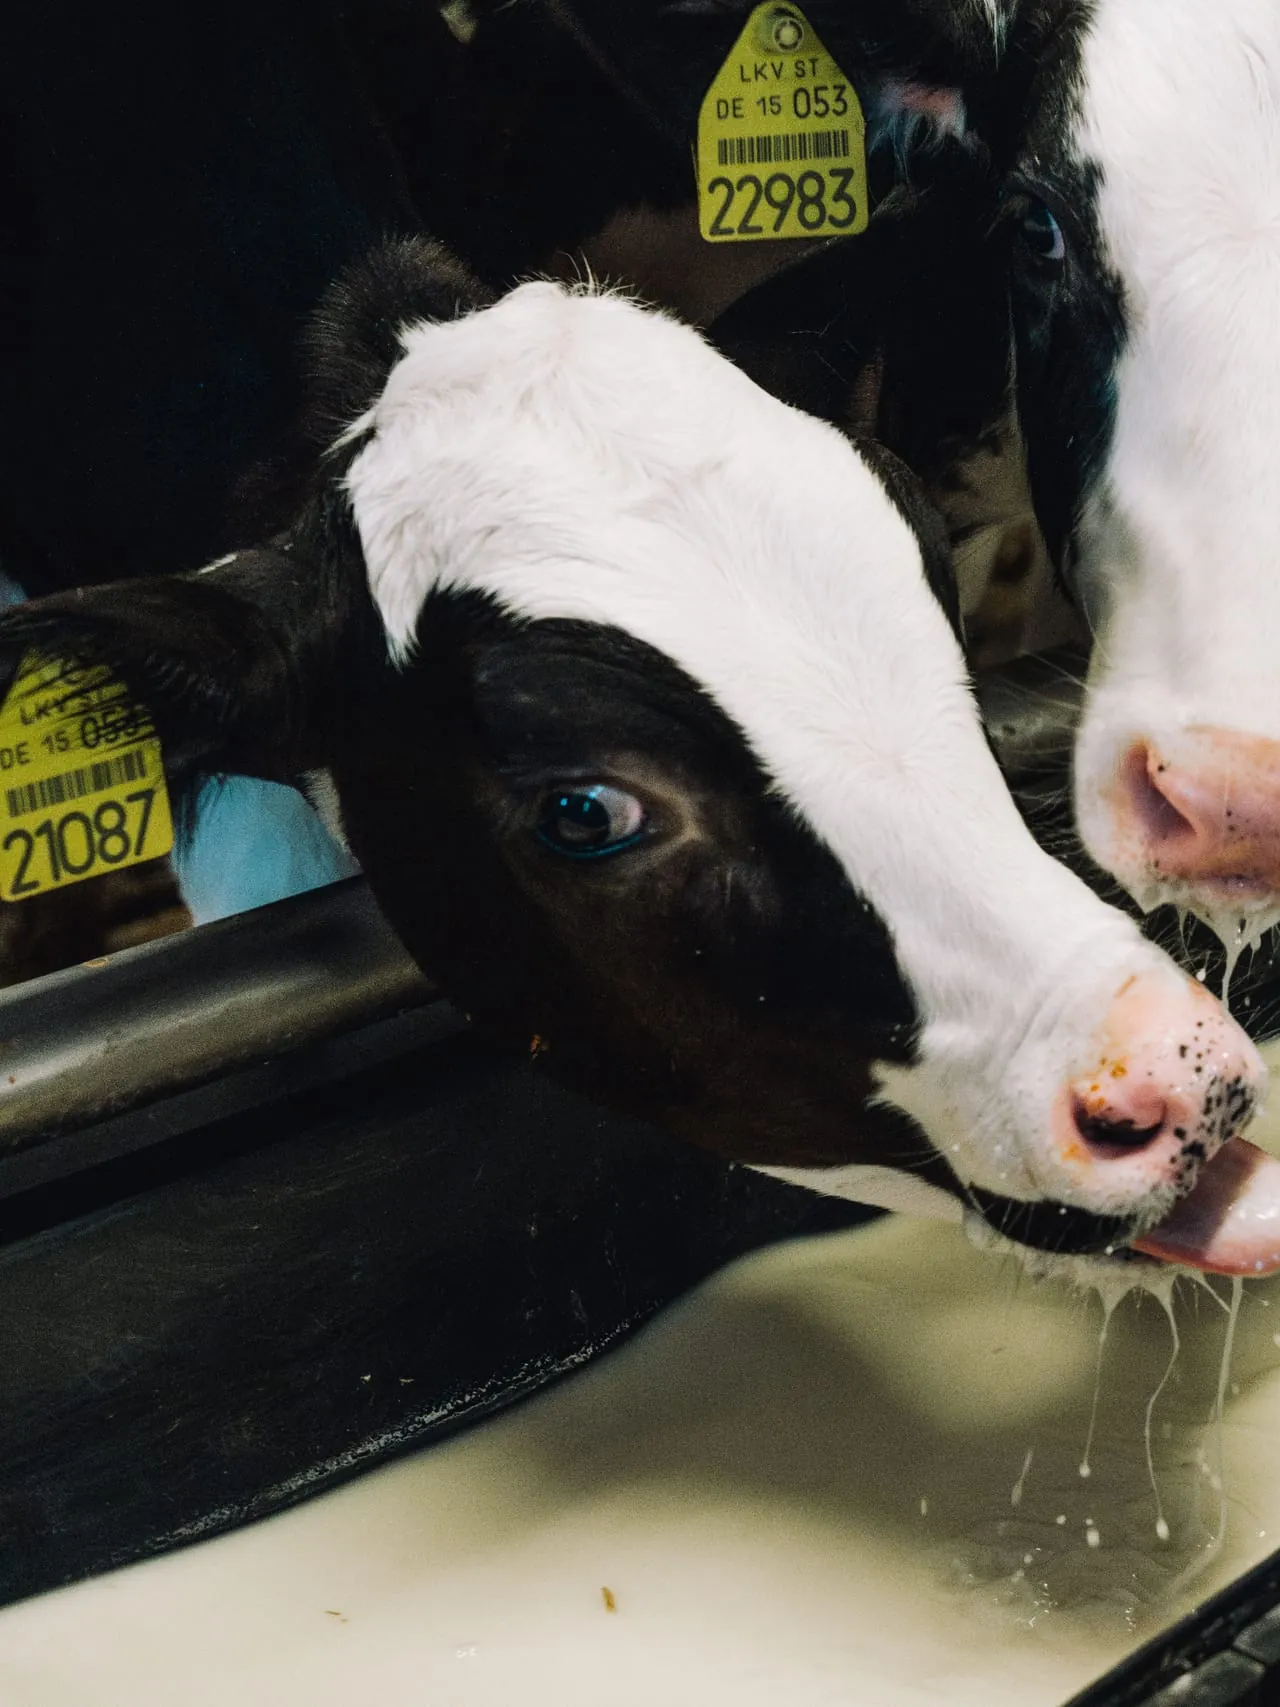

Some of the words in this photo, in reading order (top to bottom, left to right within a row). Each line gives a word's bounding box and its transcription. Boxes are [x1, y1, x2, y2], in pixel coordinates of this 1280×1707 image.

[739, 62, 784, 83] LKV
[794, 58, 819, 77] ST
[716, 98, 744, 120] DE
[756, 95, 782, 117] 15
[792, 85, 848, 119] 053
[707, 167, 857, 236] 22983
[1, 740, 30, 770] DE
[43, 730, 70, 755] 15
[3, 788, 156, 895] 21087
